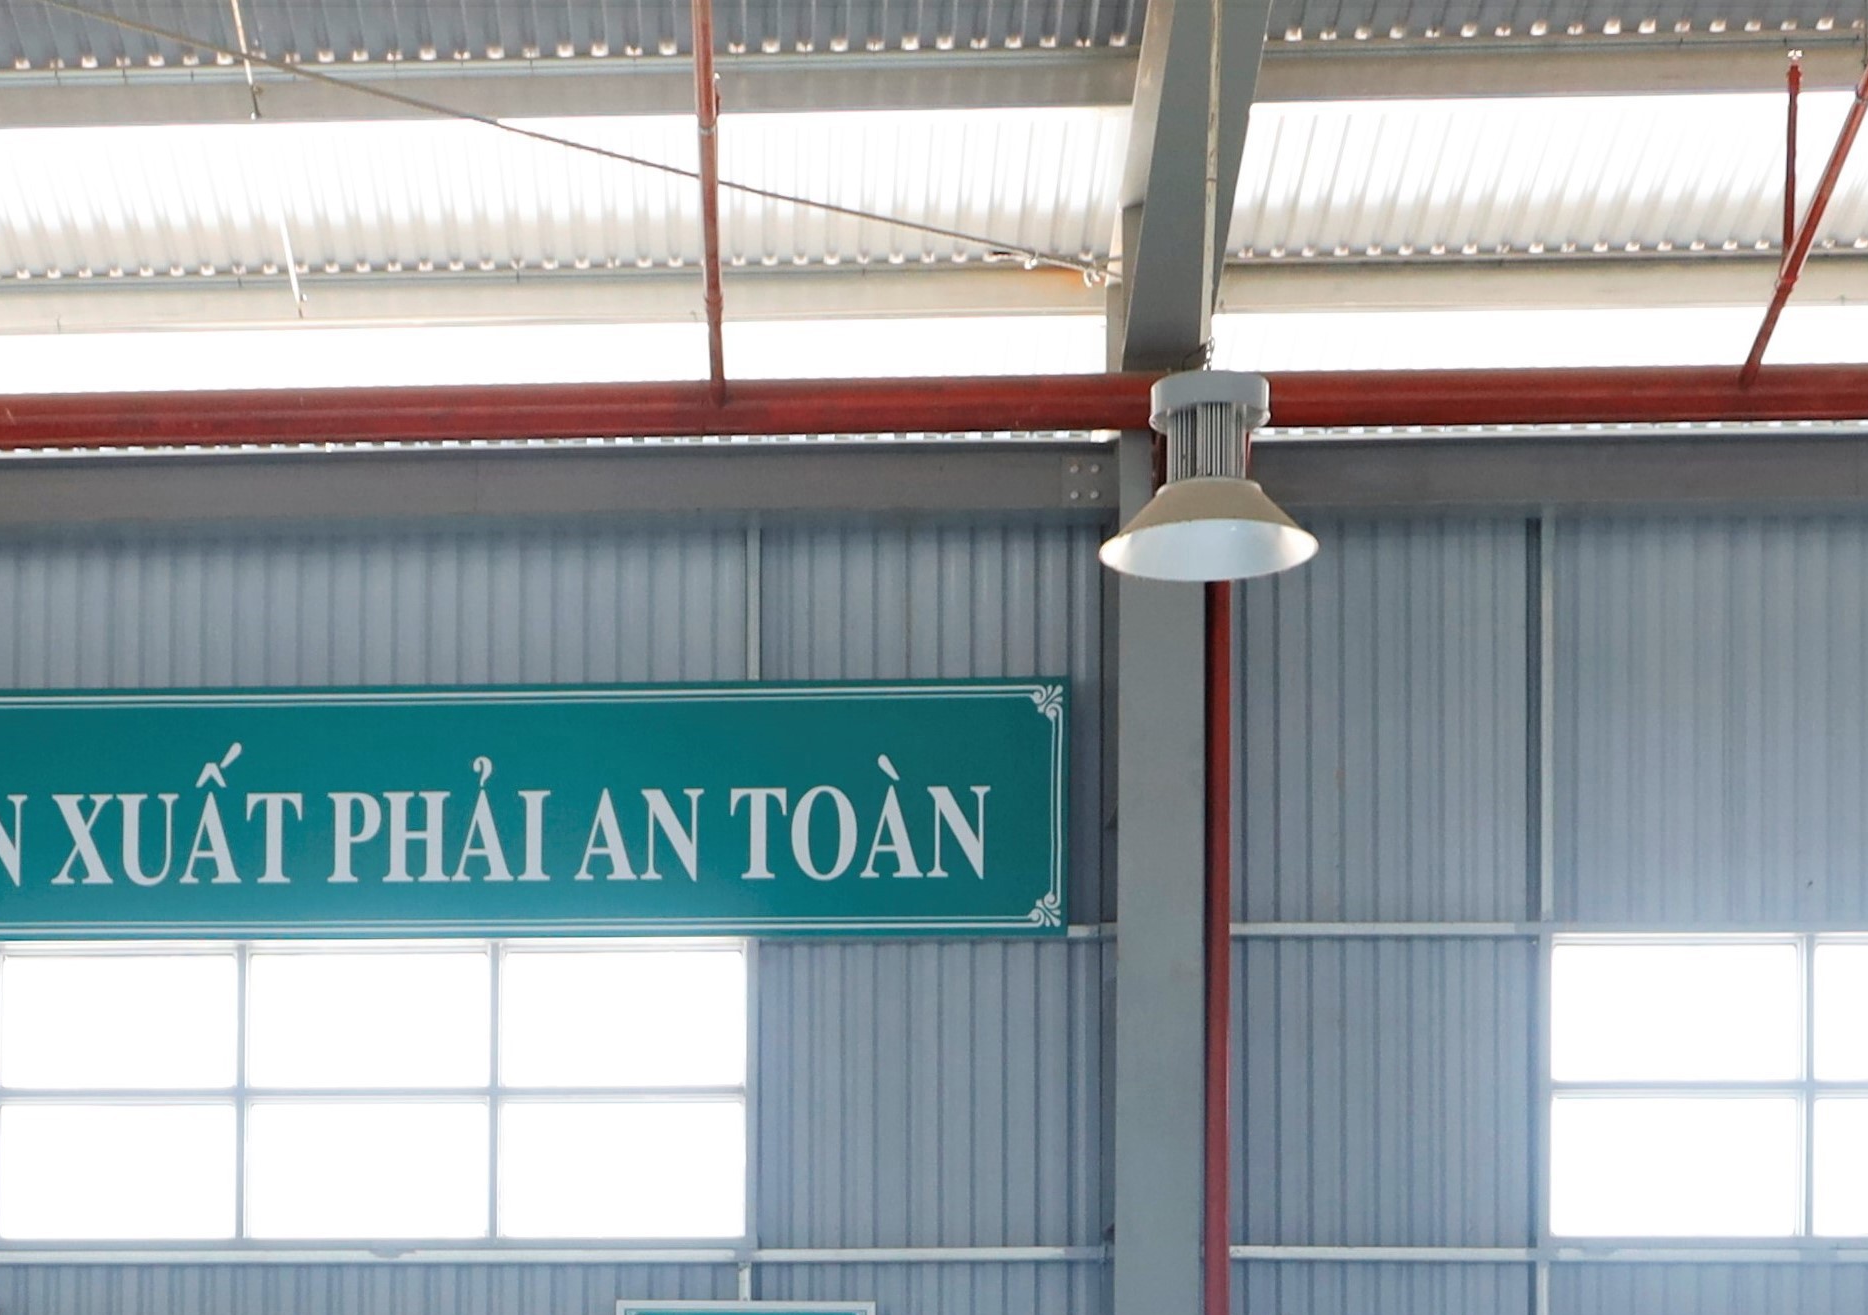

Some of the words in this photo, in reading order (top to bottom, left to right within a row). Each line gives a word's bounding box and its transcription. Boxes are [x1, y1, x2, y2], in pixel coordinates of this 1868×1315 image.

[51, 742, 303, 886] XUẤT
[327, 756, 551, 884] PHẢI
[574, 788, 705, 882] AN
[730, 754, 991, 882] TOÀN
